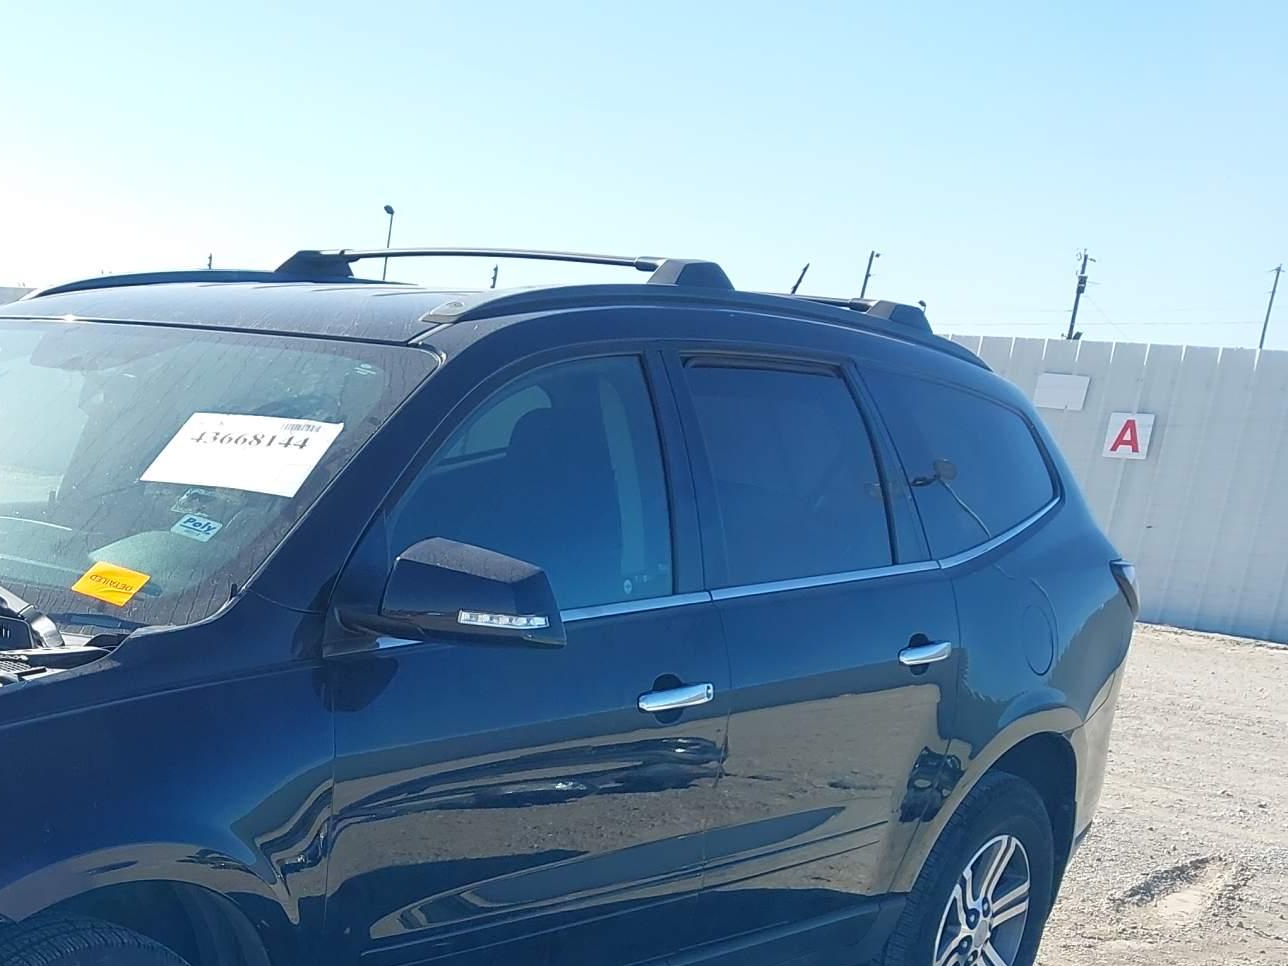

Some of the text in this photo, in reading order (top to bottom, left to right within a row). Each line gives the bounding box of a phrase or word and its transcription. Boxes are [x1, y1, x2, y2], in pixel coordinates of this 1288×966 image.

[191, 431, 310, 449] 43668144
[1110, 419, 1139, 452] A
[183, 517, 217, 533] Poly
[90, 574, 133, 592] DETAILED
